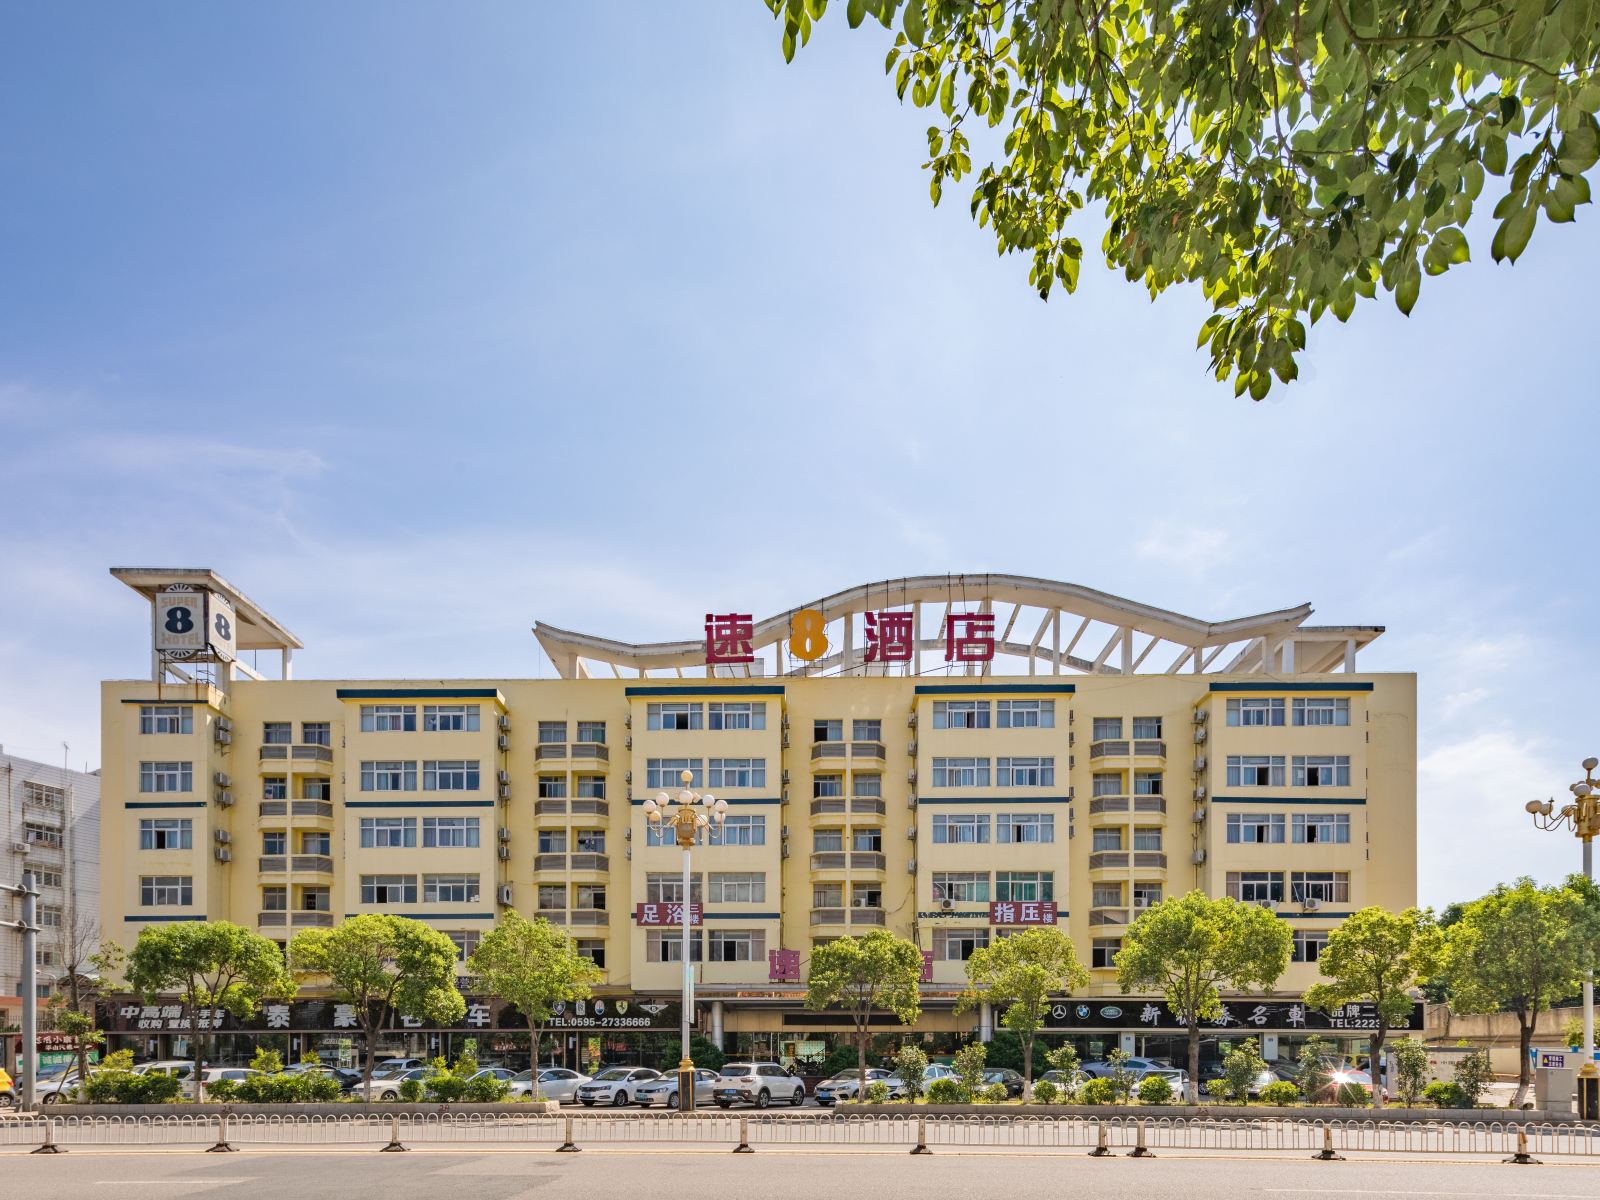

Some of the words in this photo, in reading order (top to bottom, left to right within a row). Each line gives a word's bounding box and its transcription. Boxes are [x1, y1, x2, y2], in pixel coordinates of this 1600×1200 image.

[160, 596, 198, 609] SUPER
[165, 606, 194, 634] 8
[214, 612, 232, 641] 8
[705, 609, 995, 664] 速8酒店
[640, 903, 684, 924] 足浴
[994, 902, 1041, 923] 指压
[1043, 902, 1053, 924] 三楼
[120, 1005, 183, 1019] 中高端
[549, 1017, 651, 1027] TEL:0595-27336666
[138, 1019, 163, 1029] 收购
